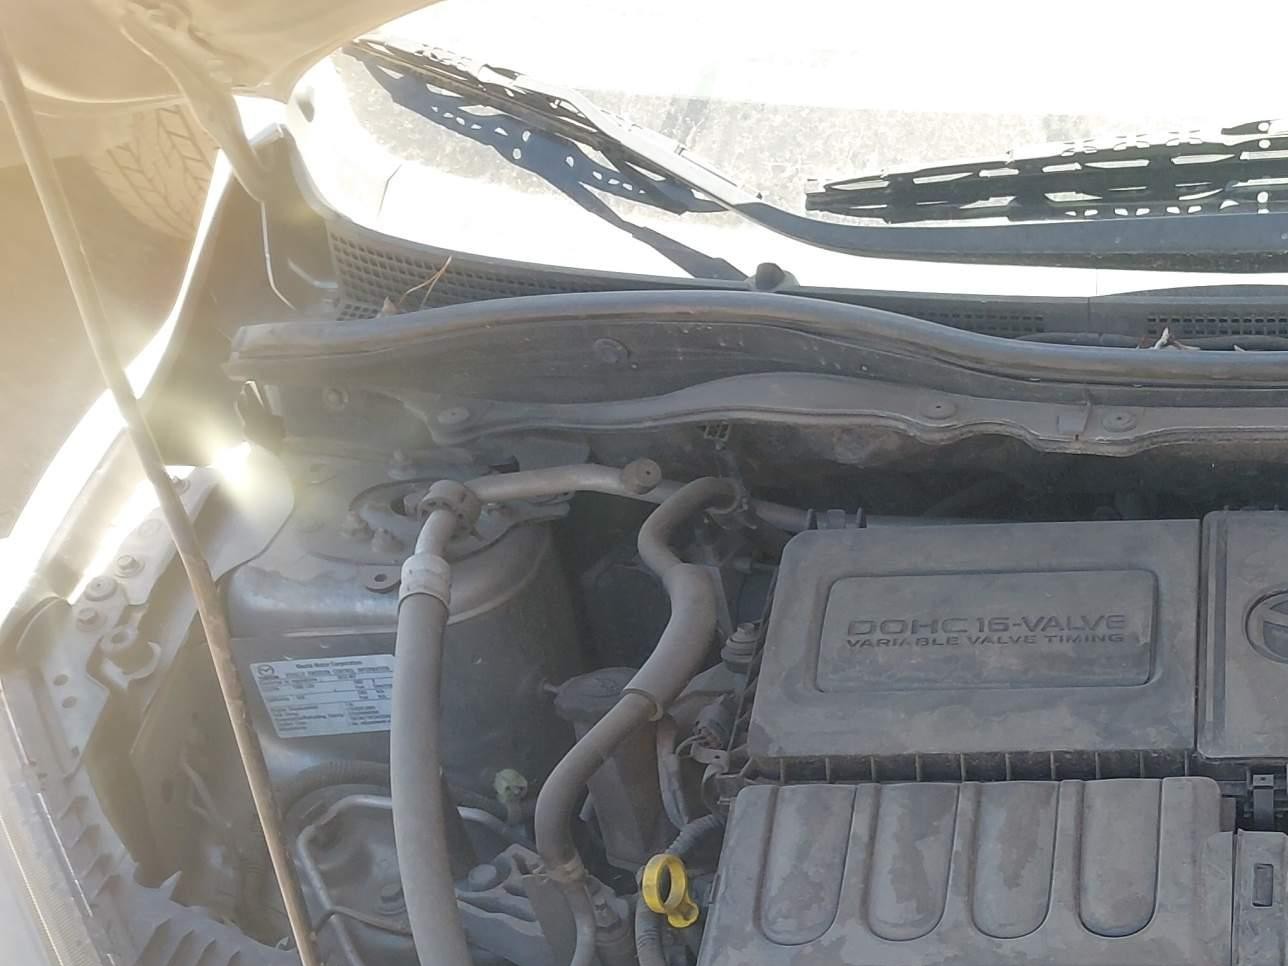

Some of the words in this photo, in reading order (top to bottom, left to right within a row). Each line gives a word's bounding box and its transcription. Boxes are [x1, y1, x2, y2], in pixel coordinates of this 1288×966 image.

[848, 617, 969, 636] DOHC
[976, 614, 1127, 633] 16-VALVE
[846, 635, 960, 649] VARIABLE
[967, 634, 1038, 646] VALVE
[1044, 632, 1125, 644] TIMING
